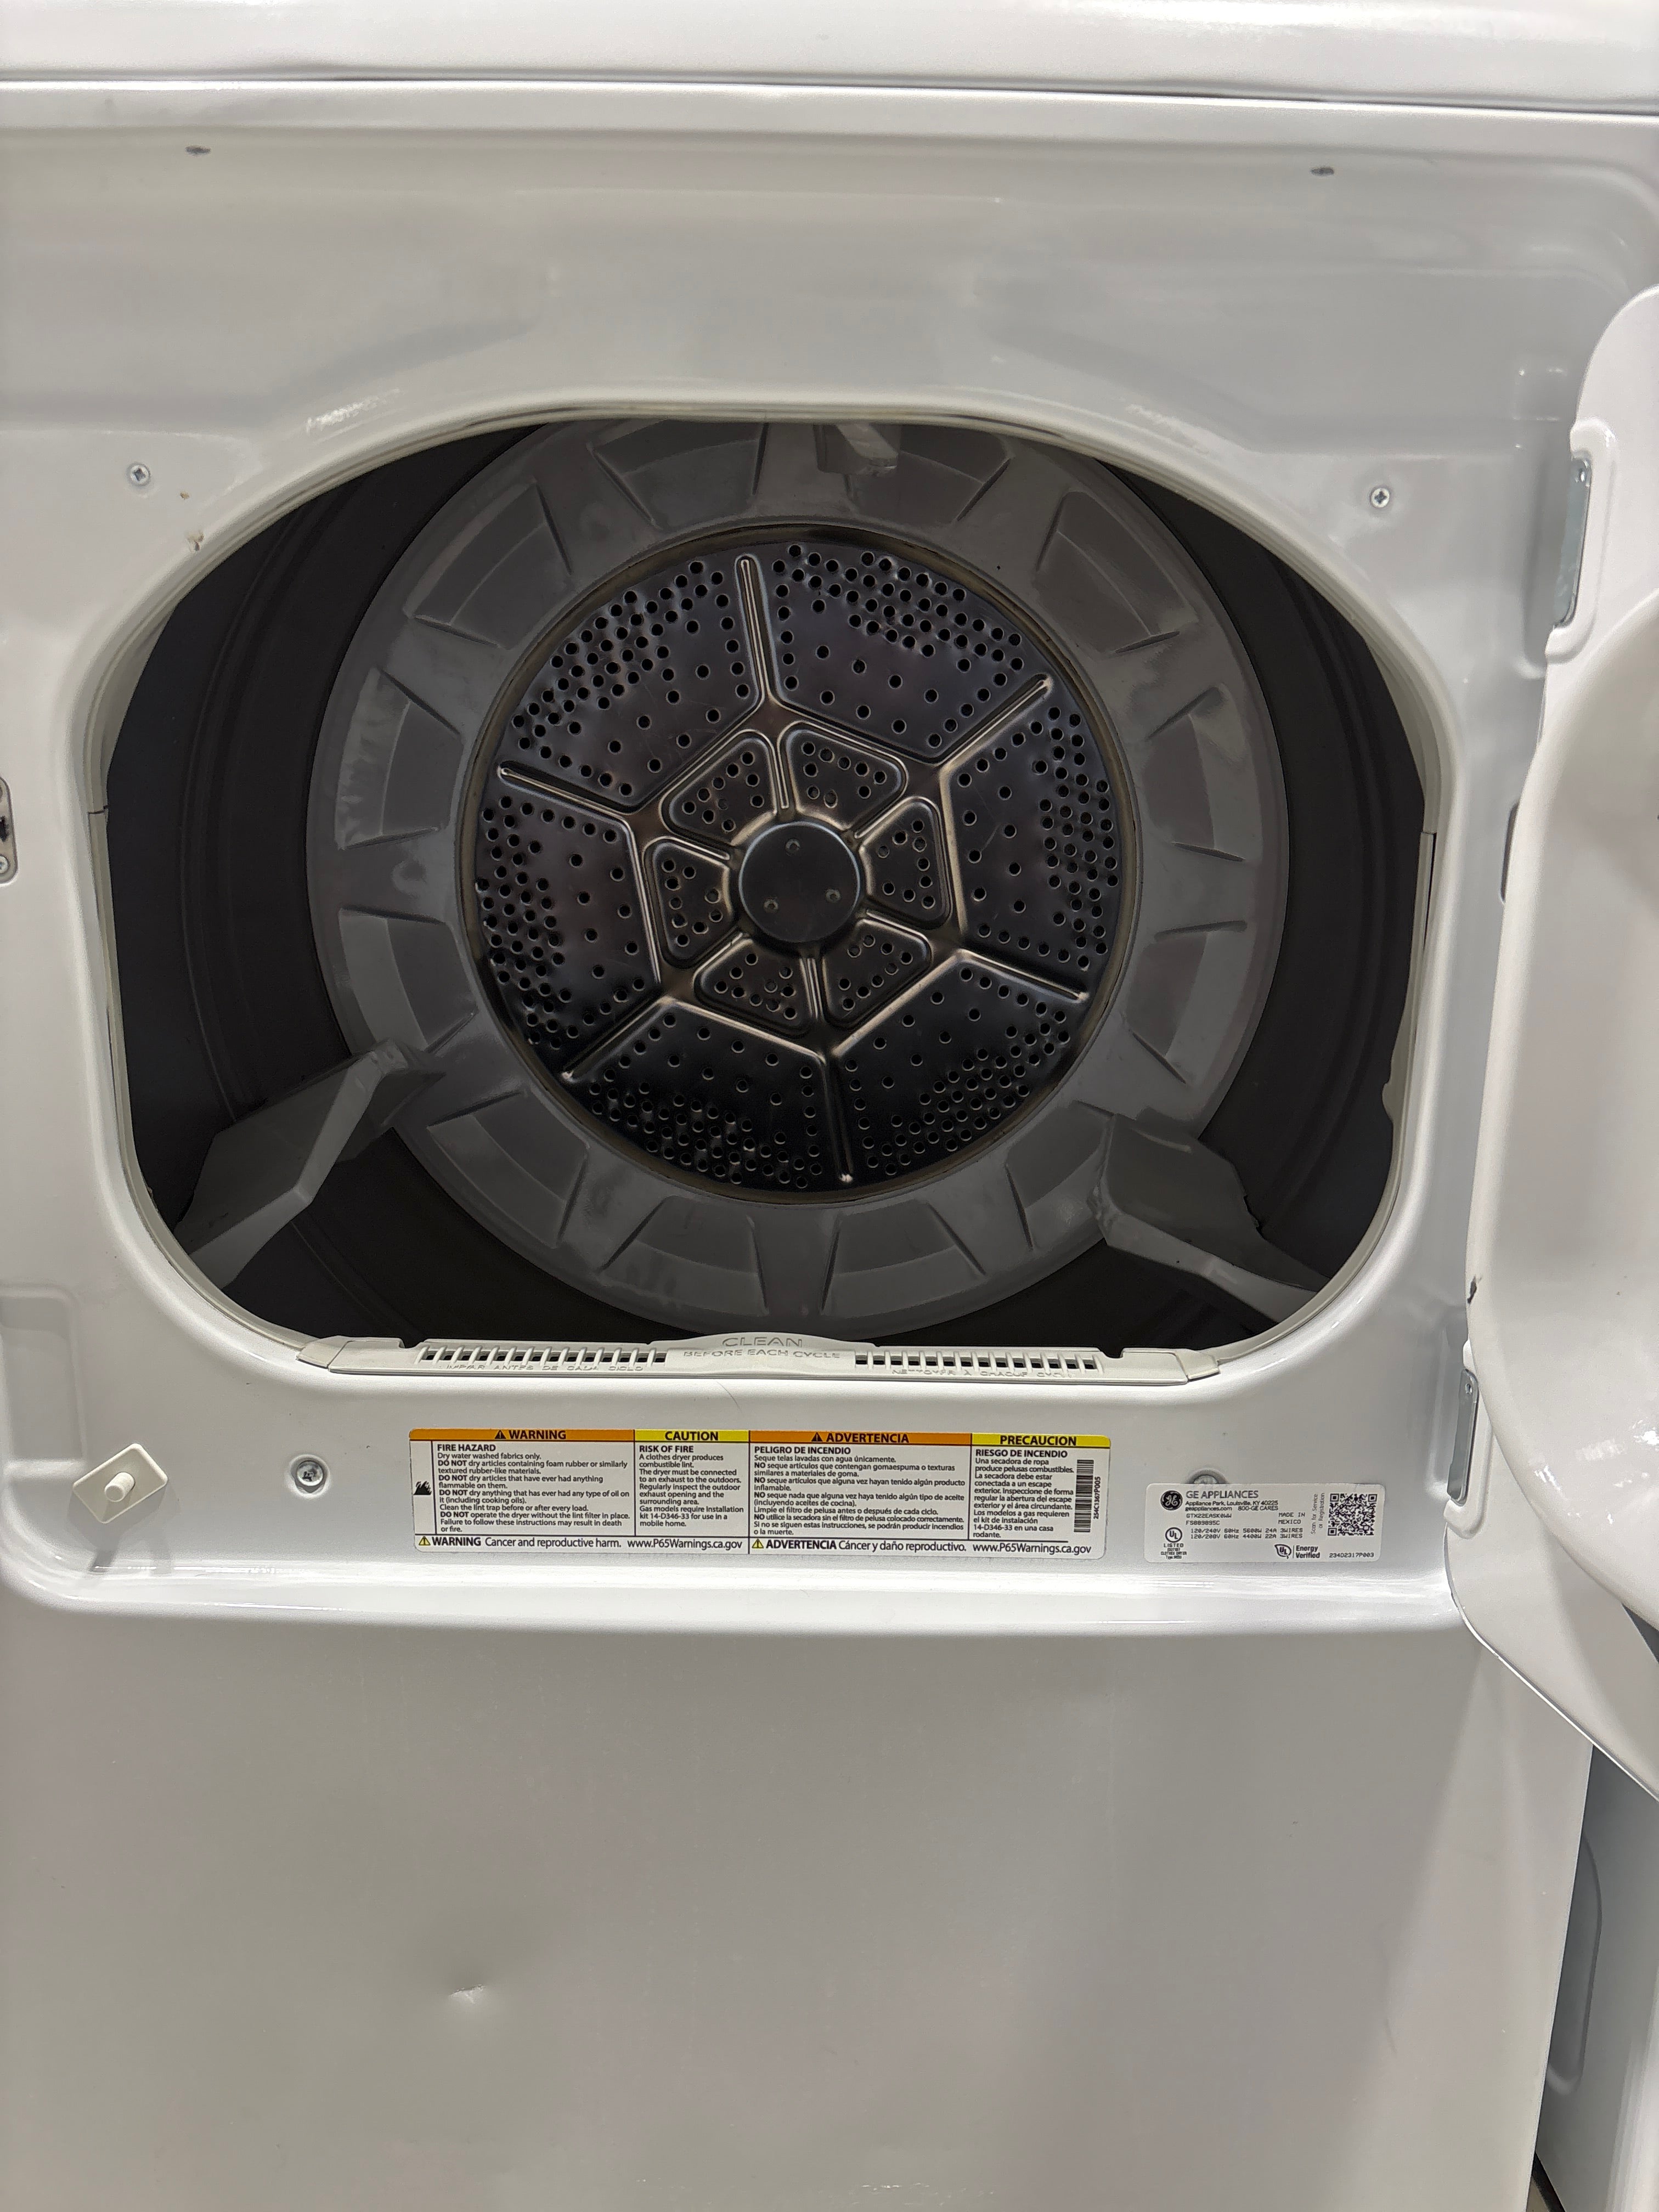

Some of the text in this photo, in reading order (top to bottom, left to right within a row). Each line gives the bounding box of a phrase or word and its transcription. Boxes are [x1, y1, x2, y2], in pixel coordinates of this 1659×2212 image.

[721, 1336, 803, 1347] CLEAN
[793, 1350, 840, 1358] CYCLE
[509, 1430, 567, 1440] WARNING
[665, 1431, 719, 1441] CAUTION
[826, 1433, 910, 1443] ADVERTENCIA
[1000, 1435, 1076, 1446] PRECAUCION
[1186, 1490, 1259, 1499] GE APPLIANCES
[431, 1537, 621, 1549] WARNING Cancer and reproductive harm.
[627, 1539, 742, 1550] www.P65Warnings.ca.gov
[838, 1542, 871, 1550] Cáncer
[872, 1544, 878, 1552] y
[879, 1542, 904, 1550] daño
[905, 1542, 967, 1553] reproductivo.
[973, 1544, 1091, 1554] www.P65Warnings.ca.gov
